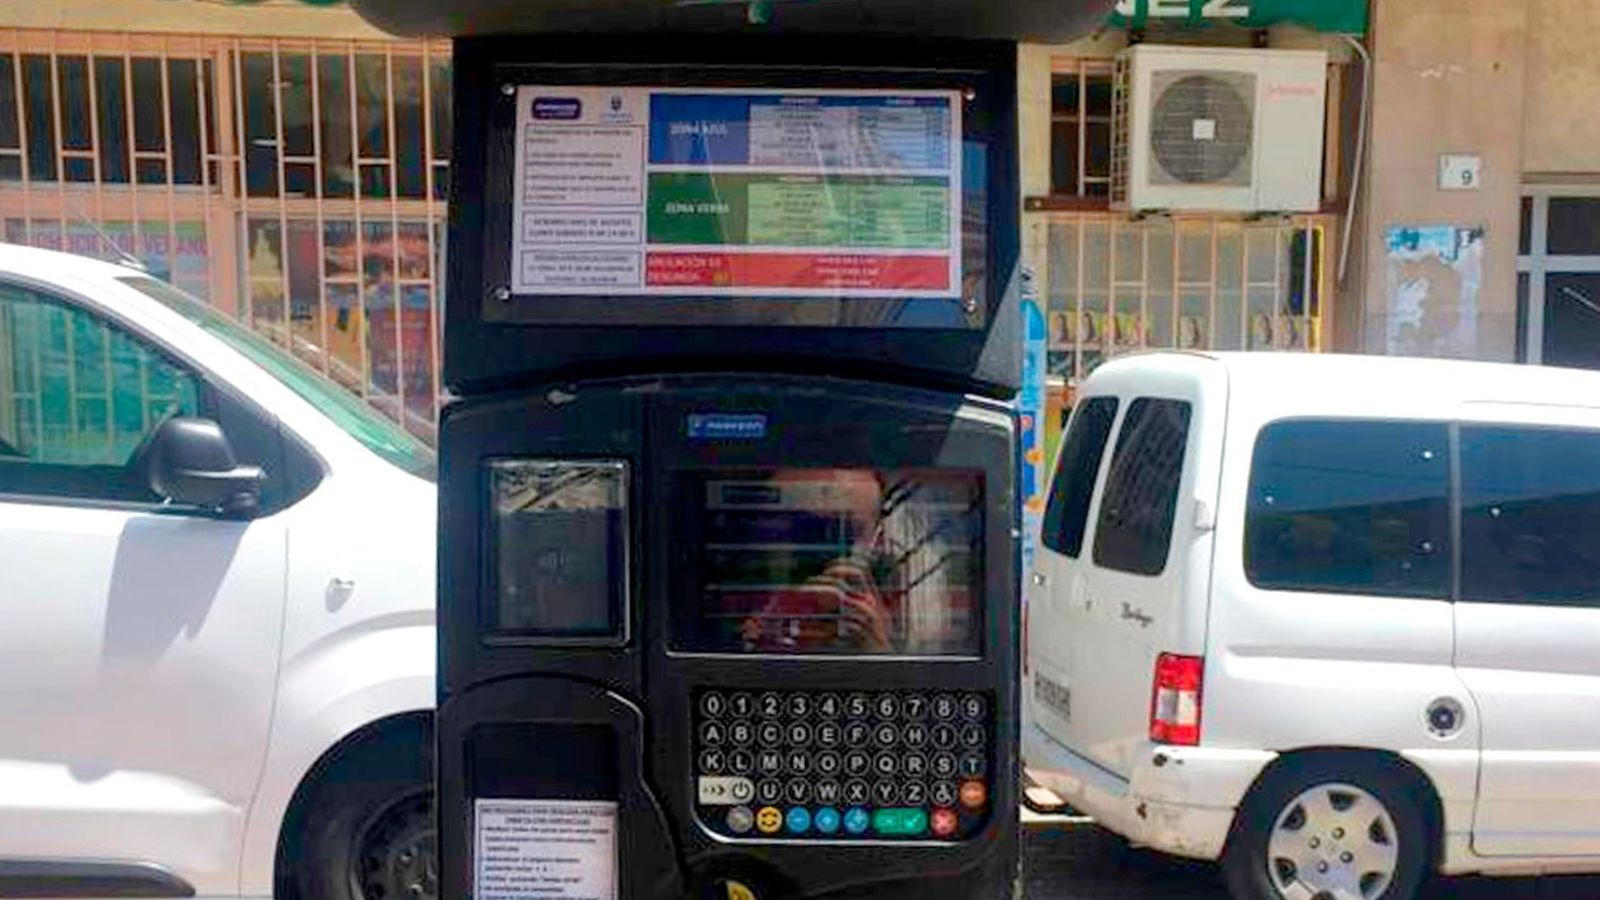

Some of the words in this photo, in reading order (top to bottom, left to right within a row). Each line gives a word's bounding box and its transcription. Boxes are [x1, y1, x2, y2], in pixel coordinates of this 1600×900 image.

[1461, 170, 1472, 185] 9
[737, 698, 746, 713] 1
[765, 698, 777, 715] 2
[793, 698, 806, 715] 3
[821, 698, 835, 715] 4
[852, 698, 864, 715] 5
[880, 698, 893, 716] 6
[908, 698, 921, 716] 7
[938, 699, 951, 717] 8
[967, 699, 979, 717] 9
[706, 725, 720, 741] A
[735, 726, 748, 742] B
[763, 726, 777, 742] C
[792, 726, 807, 742] D
[822, 727, 835, 743] E
[851, 727, 863, 743] F
[879, 727, 894, 743] G
[908, 728, 922, 743] H
[941, 729, 948, 744] I
[966, 729, 979, 745] J
[706, 753, 719, 769] K
[735, 754, 747, 770] L
[762, 755, 777, 769] M
[793, 755, 806, 770] N
[851, 756, 864, 771] P
[879, 756, 894, 772] Q
[908, 756, 922, 772] R
[937, 757, 951, 773] S
[967, 757, 978, 774] T
[763, 783, 777, 799] U
[792, 783, 805, 799] V
[819, 784, 837, 799] W
[850, 785, 863, 799] X
[879, 784, 892, 799] Y
[908, 785, 921, 801] Z
